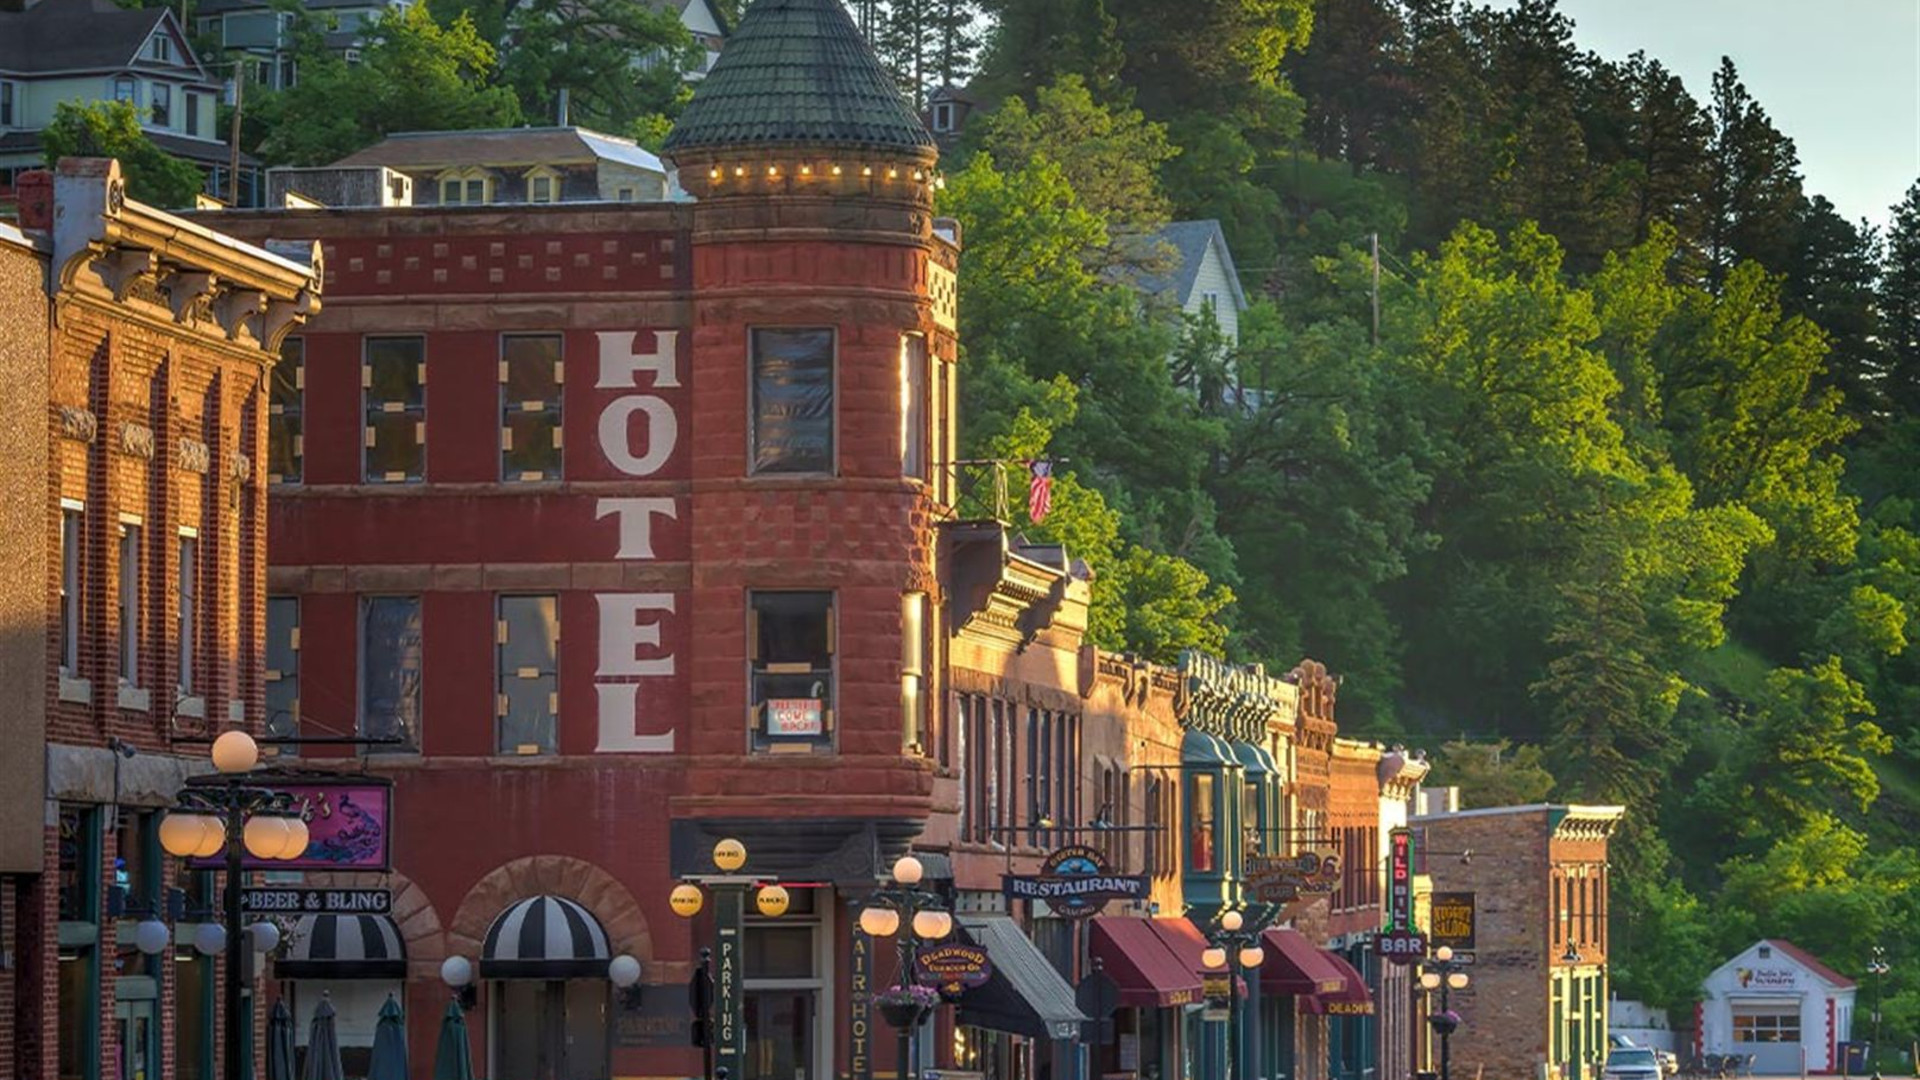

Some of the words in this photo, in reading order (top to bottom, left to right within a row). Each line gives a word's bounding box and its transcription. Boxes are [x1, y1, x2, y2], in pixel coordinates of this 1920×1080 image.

[594, 331, 682, 753] HOTEL
[1395, 834, 1408, 880] WILD
[249, 891, 300, 909] BEER
[304, 891, 322, 909] &
[326, 891, 387, 909] BLING
[1013, 877, 1141, 897] RESTAURANT
[1394, 885, 1406, 930] BILL
[920, 947, 986, 966] DEADWOOD
[1381, 938, 1422, 953] BAR
[722, 942, 732, 1042] PARKING
